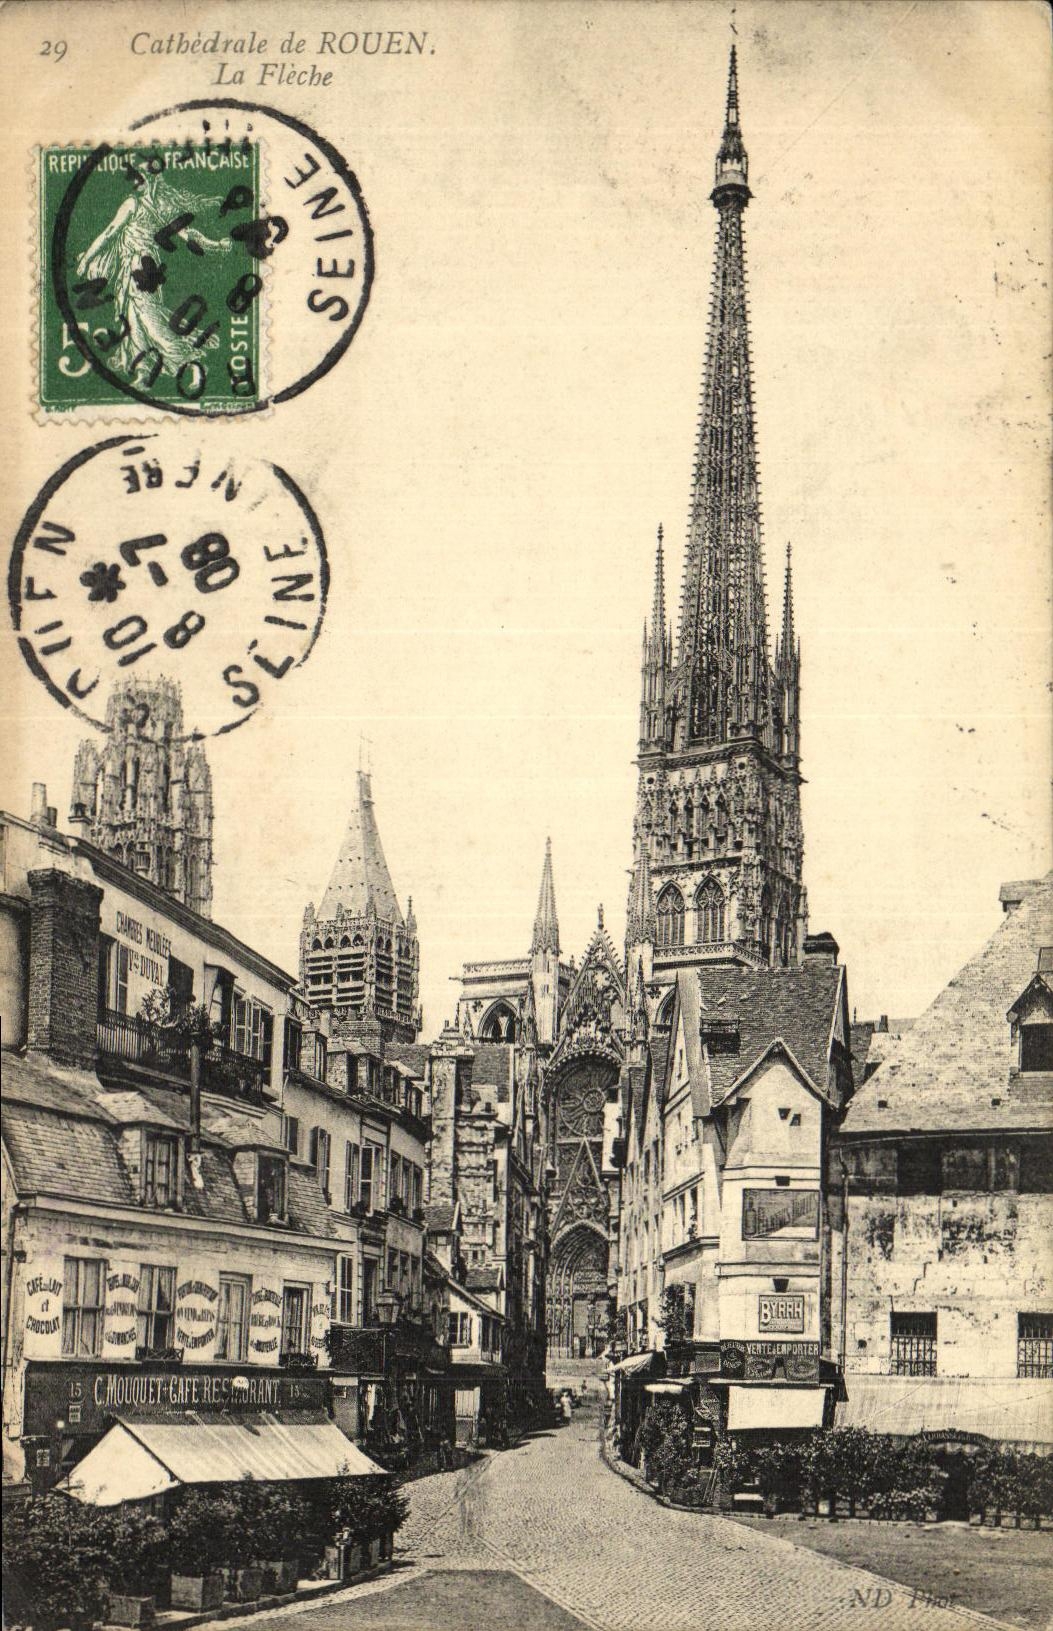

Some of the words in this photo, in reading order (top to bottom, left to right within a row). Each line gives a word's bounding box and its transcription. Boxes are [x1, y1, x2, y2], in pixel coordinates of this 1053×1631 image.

[760, 1300, 803, 1326] BYRRH
[26, 1314, 61, 1335] CHOCOLAT
[746, 1343, 773, 1355] VENTE
[777, 1343, 819, 1356] EMPORTER
[70, 1382, 82, 1398] 15
